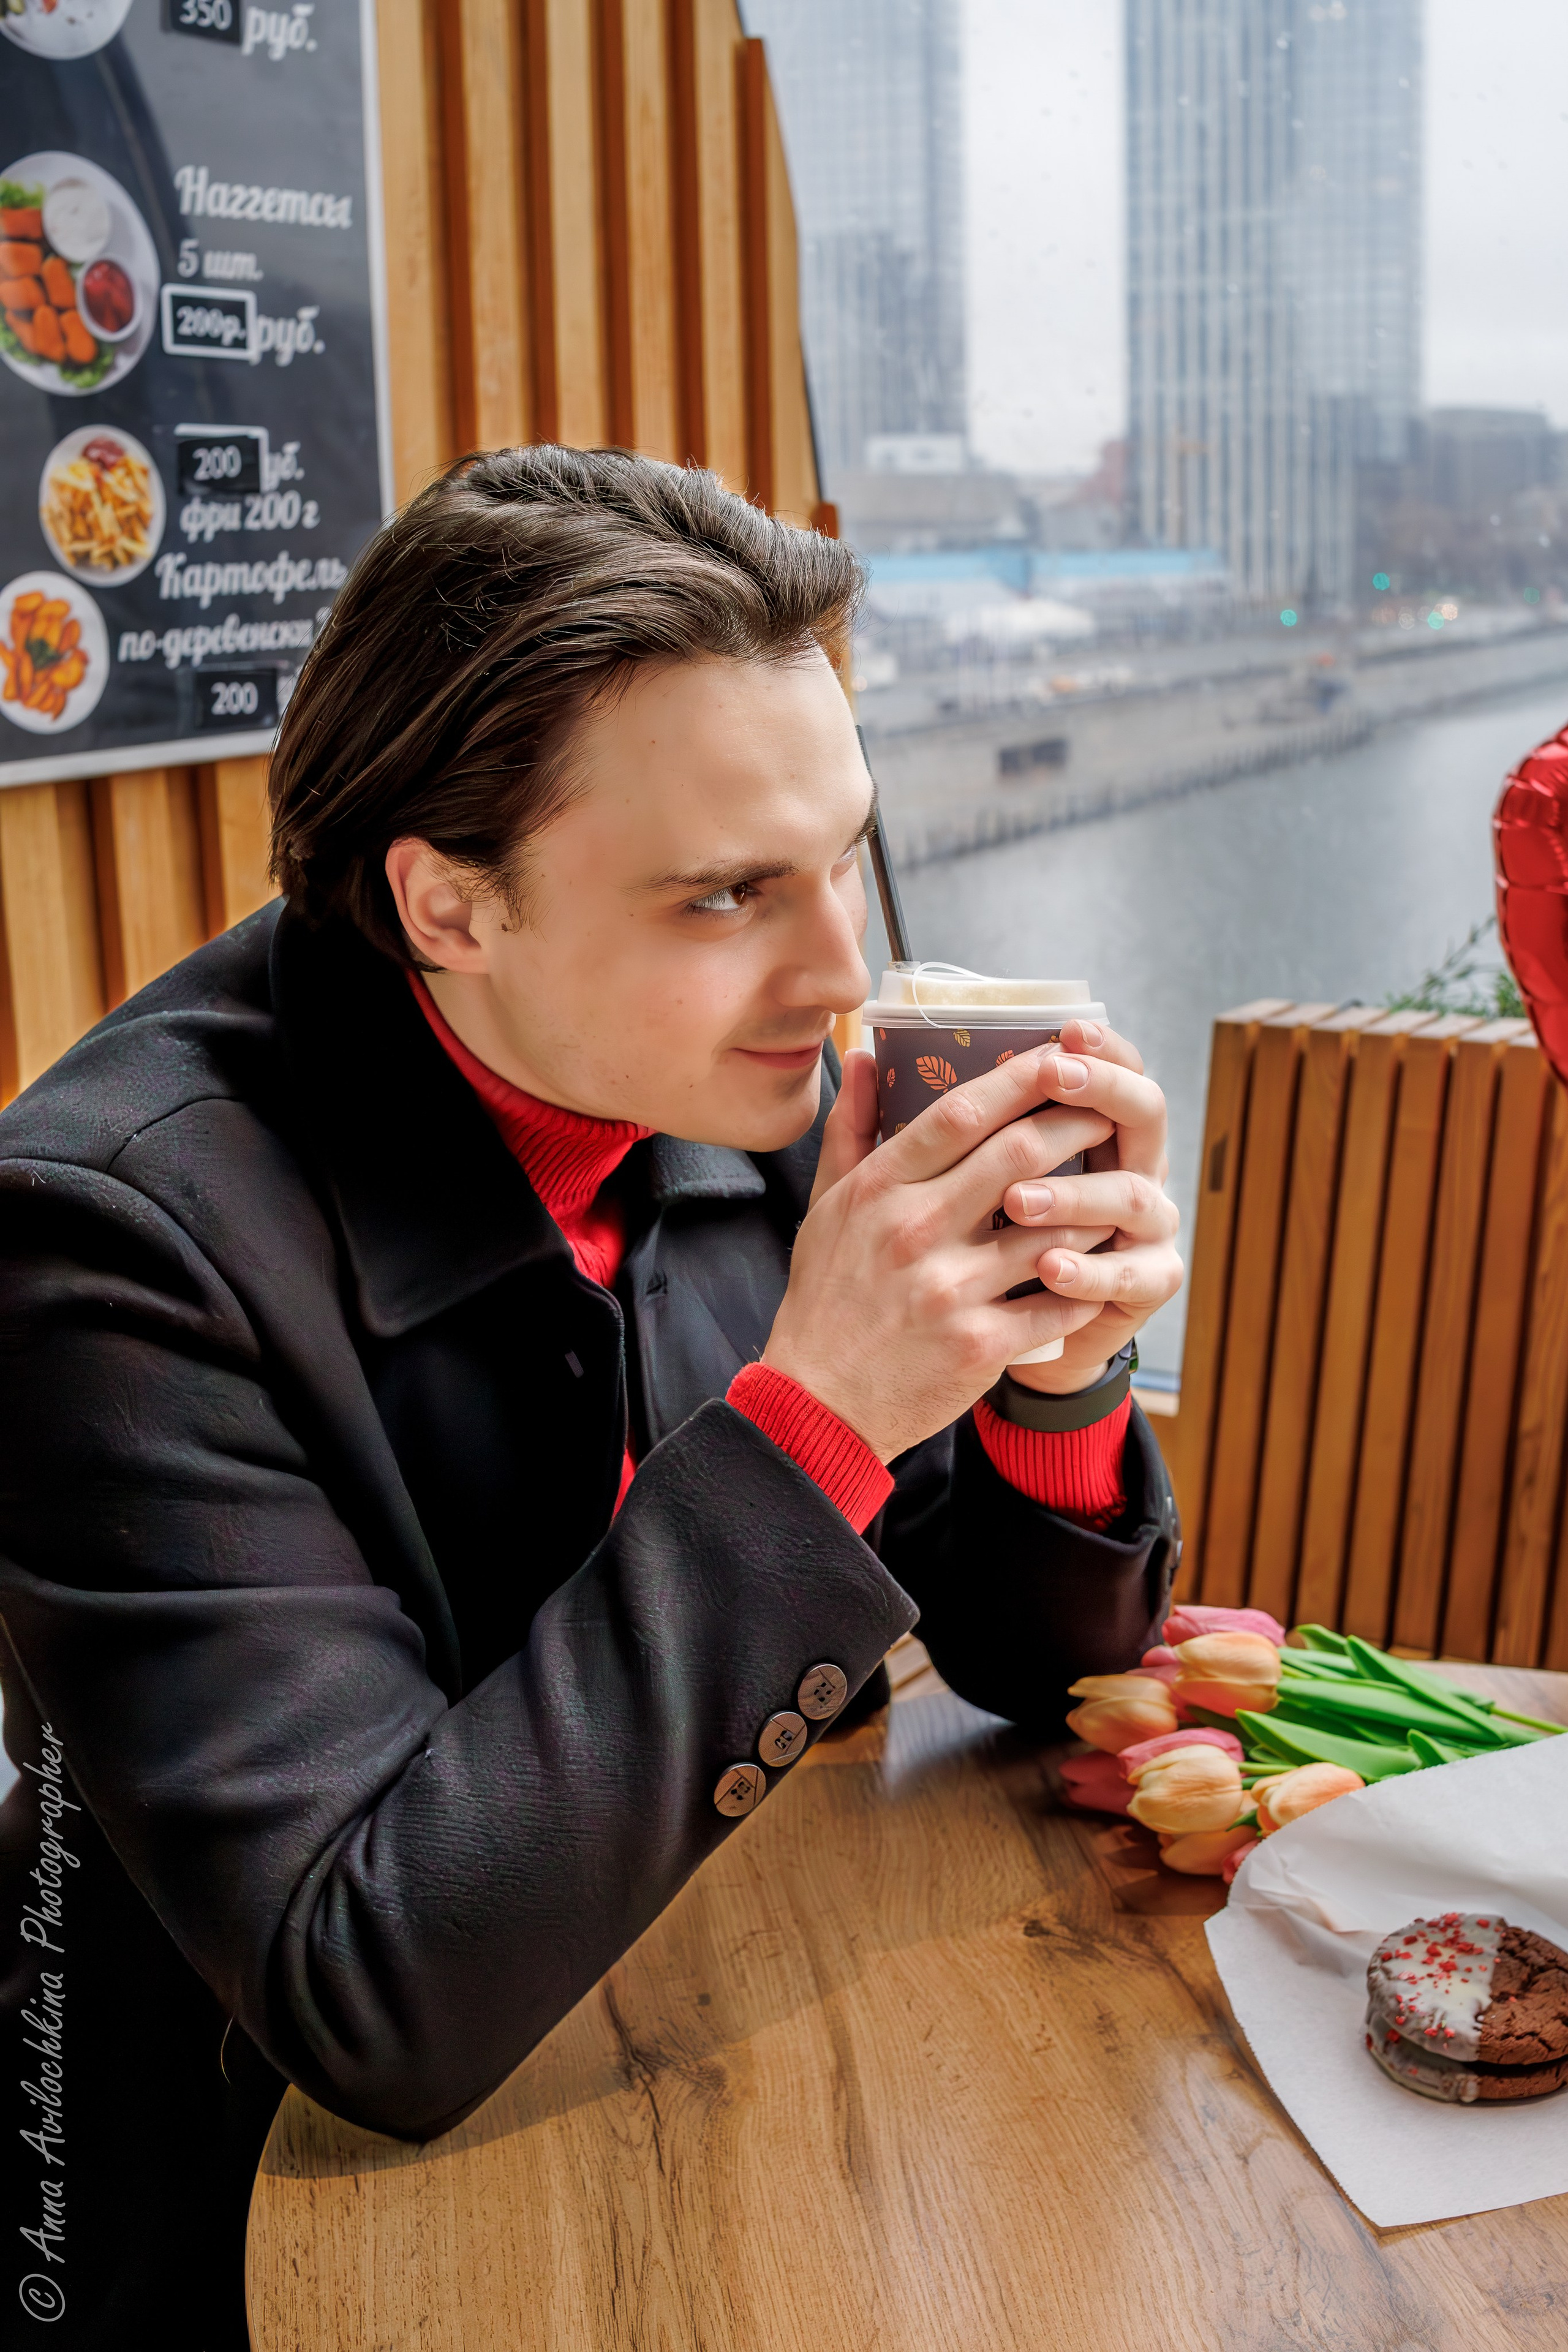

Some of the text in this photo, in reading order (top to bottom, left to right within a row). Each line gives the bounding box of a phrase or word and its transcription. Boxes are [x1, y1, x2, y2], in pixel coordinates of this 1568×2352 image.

[179, 0, 318, 61] 350 руб.
[173, 165, 353, 230] Наггетсы
[177, 238, 265, 281] 5 шт.
[176, 306, 326, 367] 200р. руб.
[192, 445, 243, 481] 200
[179, 496, 242, 543] фри
[154, 549, 347, 609] Картофель
[210, 680, 258, 715] 200
